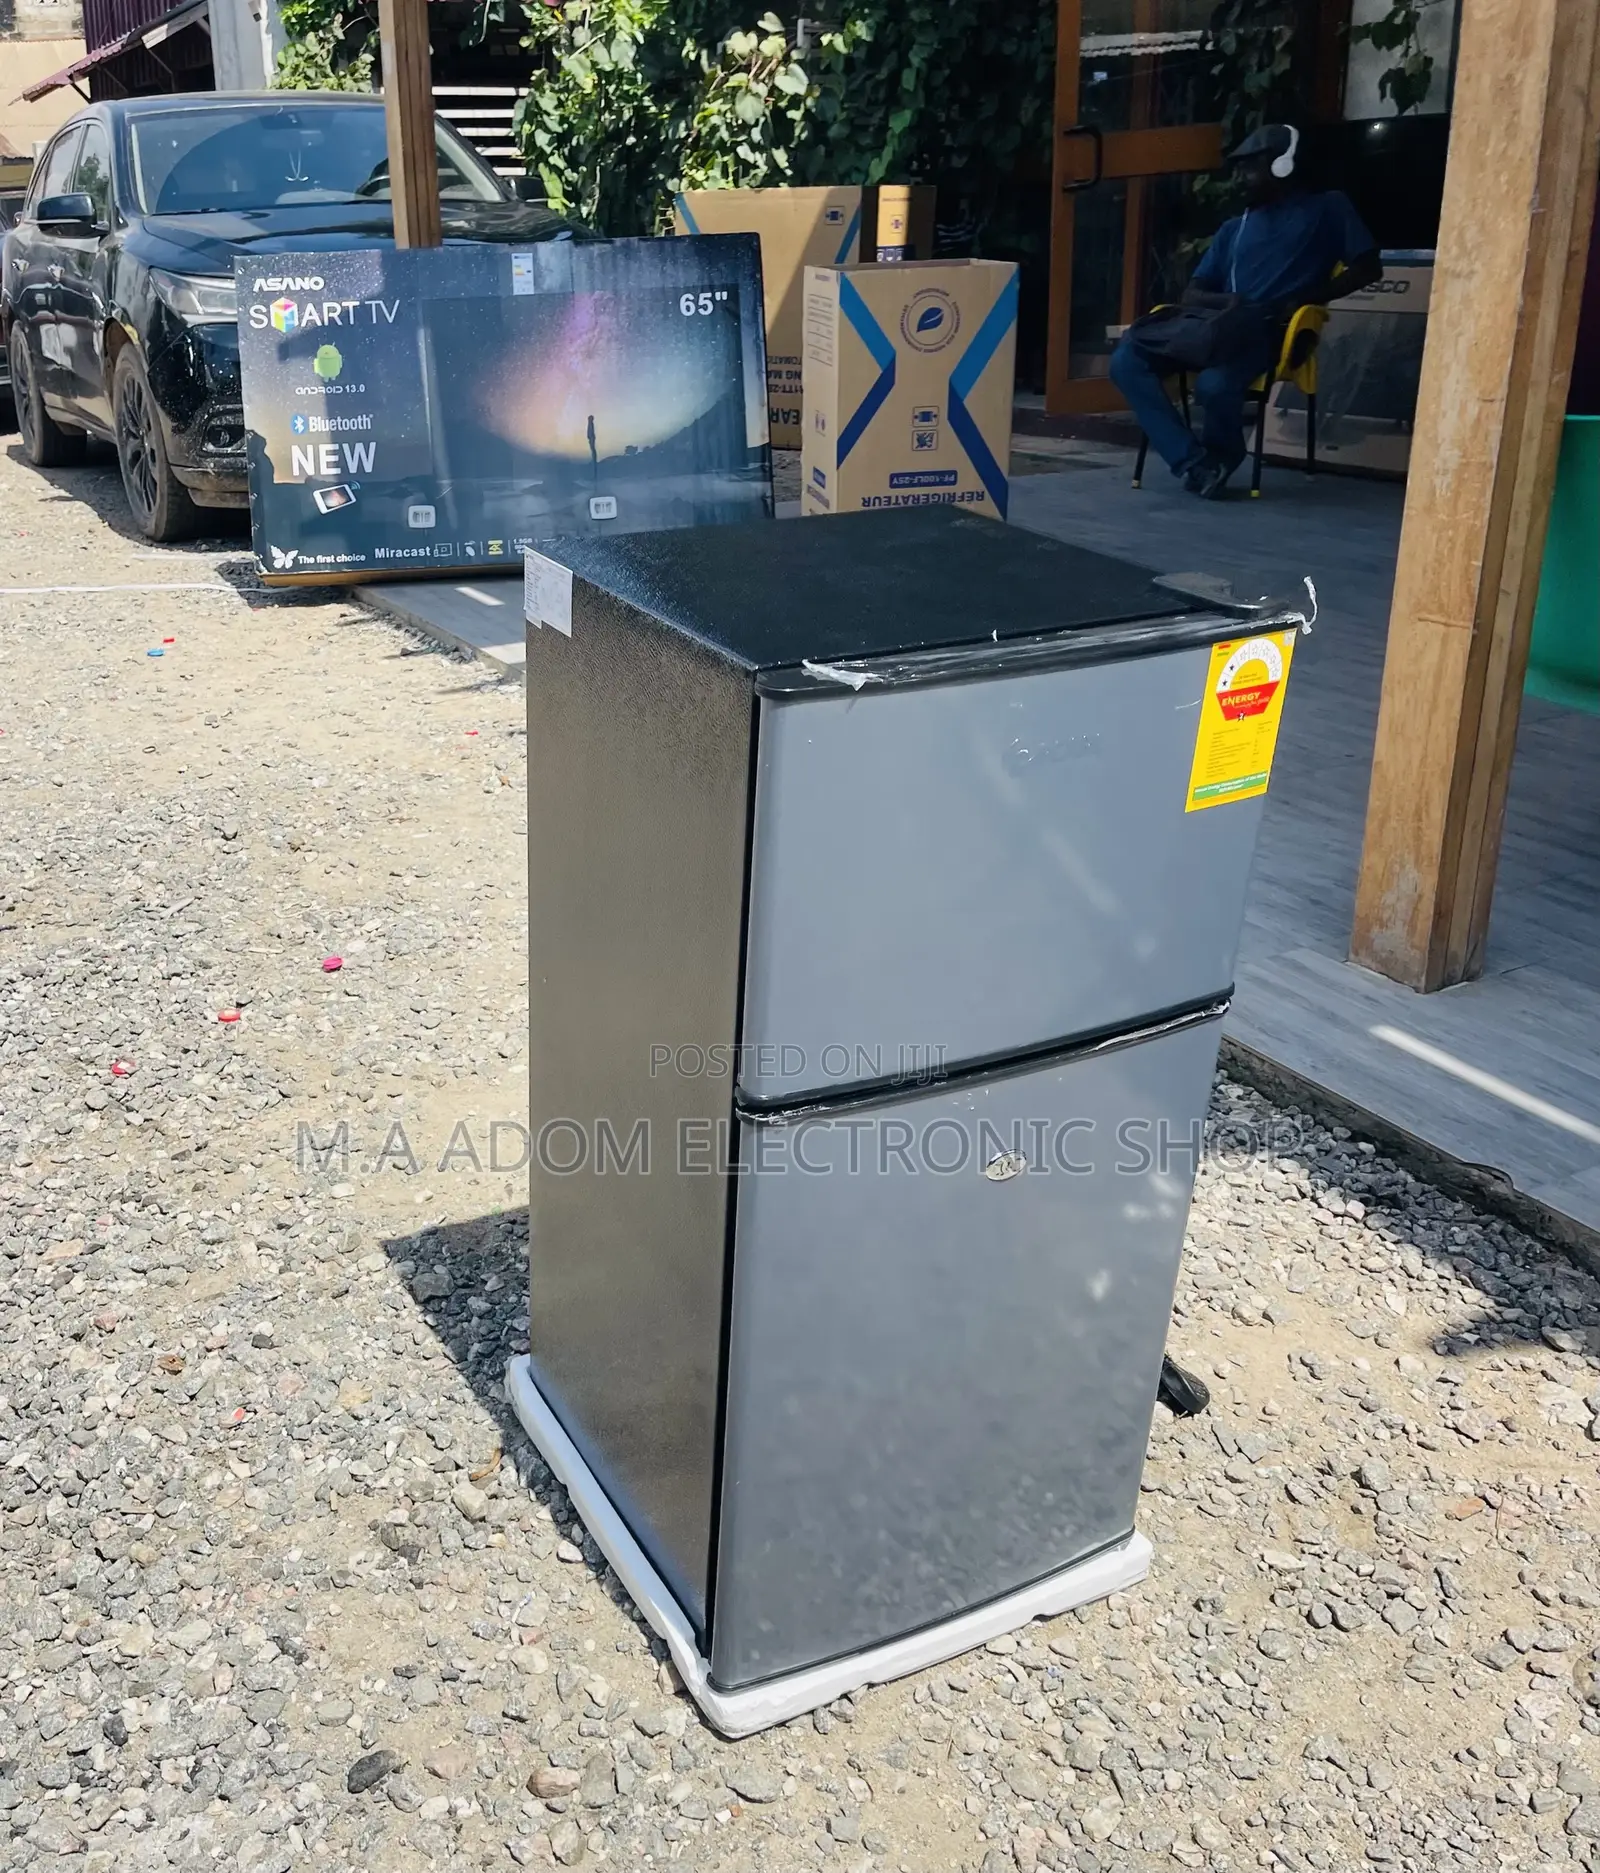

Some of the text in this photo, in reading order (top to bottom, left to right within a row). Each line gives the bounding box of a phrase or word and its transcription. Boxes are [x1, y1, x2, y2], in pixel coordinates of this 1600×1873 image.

[253, 276, 325, 293] ASANO
[364, 300, 400, 324] TV
[679, 291, 728, 317] 65"
[345, 384, 366, 394] 13.0
[291, 441, 377, 476] NEW
[297, 553, 366, 565] The first choice
[374, 546, 431, 559] Miracast
[1221, 691, 1261, 707] ENERGY
